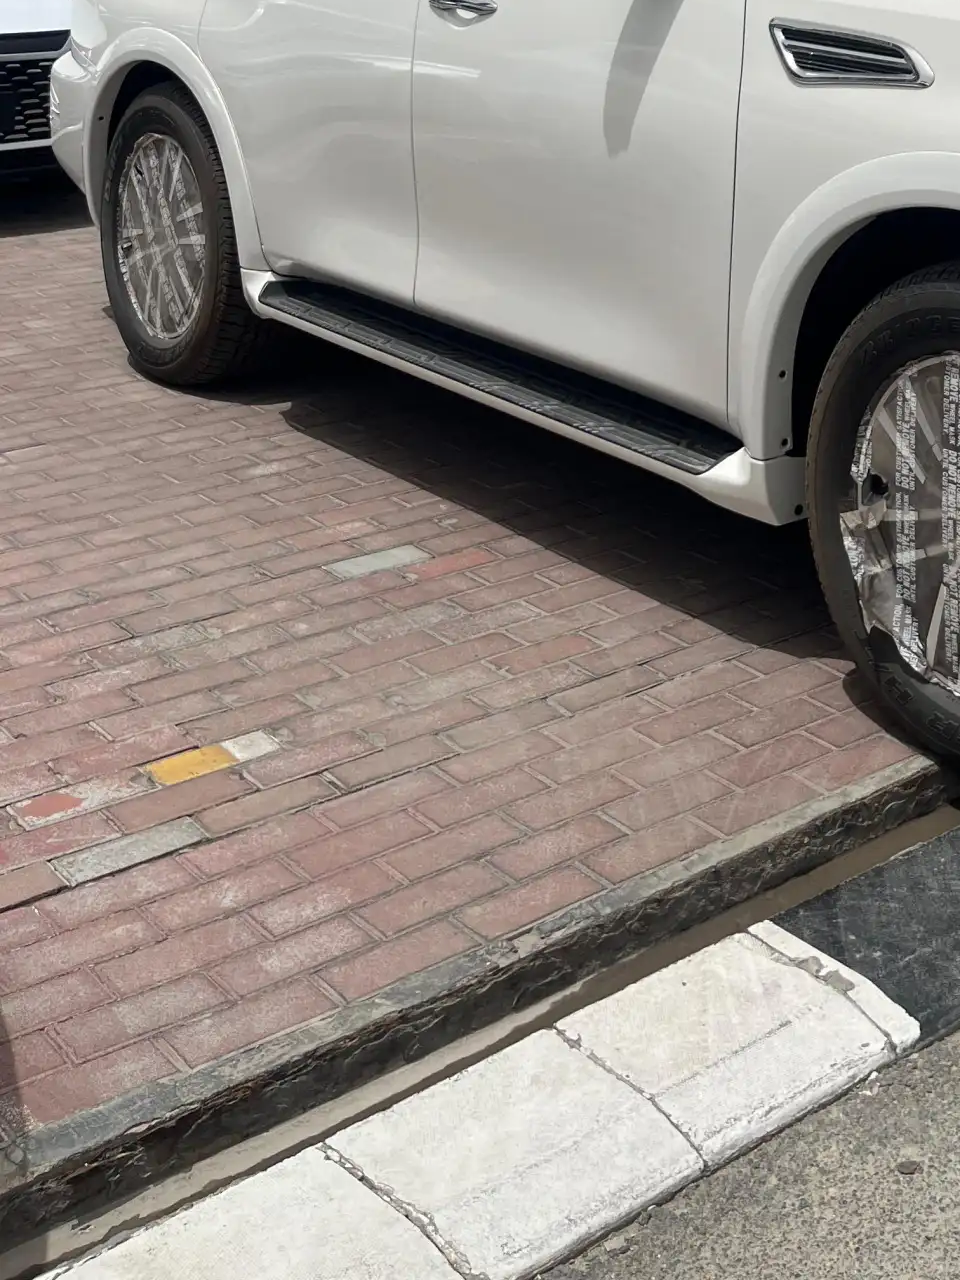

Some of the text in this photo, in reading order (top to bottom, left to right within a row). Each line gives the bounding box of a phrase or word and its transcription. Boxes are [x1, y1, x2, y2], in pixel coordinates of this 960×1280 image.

[948, 450, 957, 462] DO
[948, 464, 956, 481] NOT
[902, 478, 909, 488] DO
[948, 483, 956, 518] REMOVE
[903, 589, 910, 600] DO
